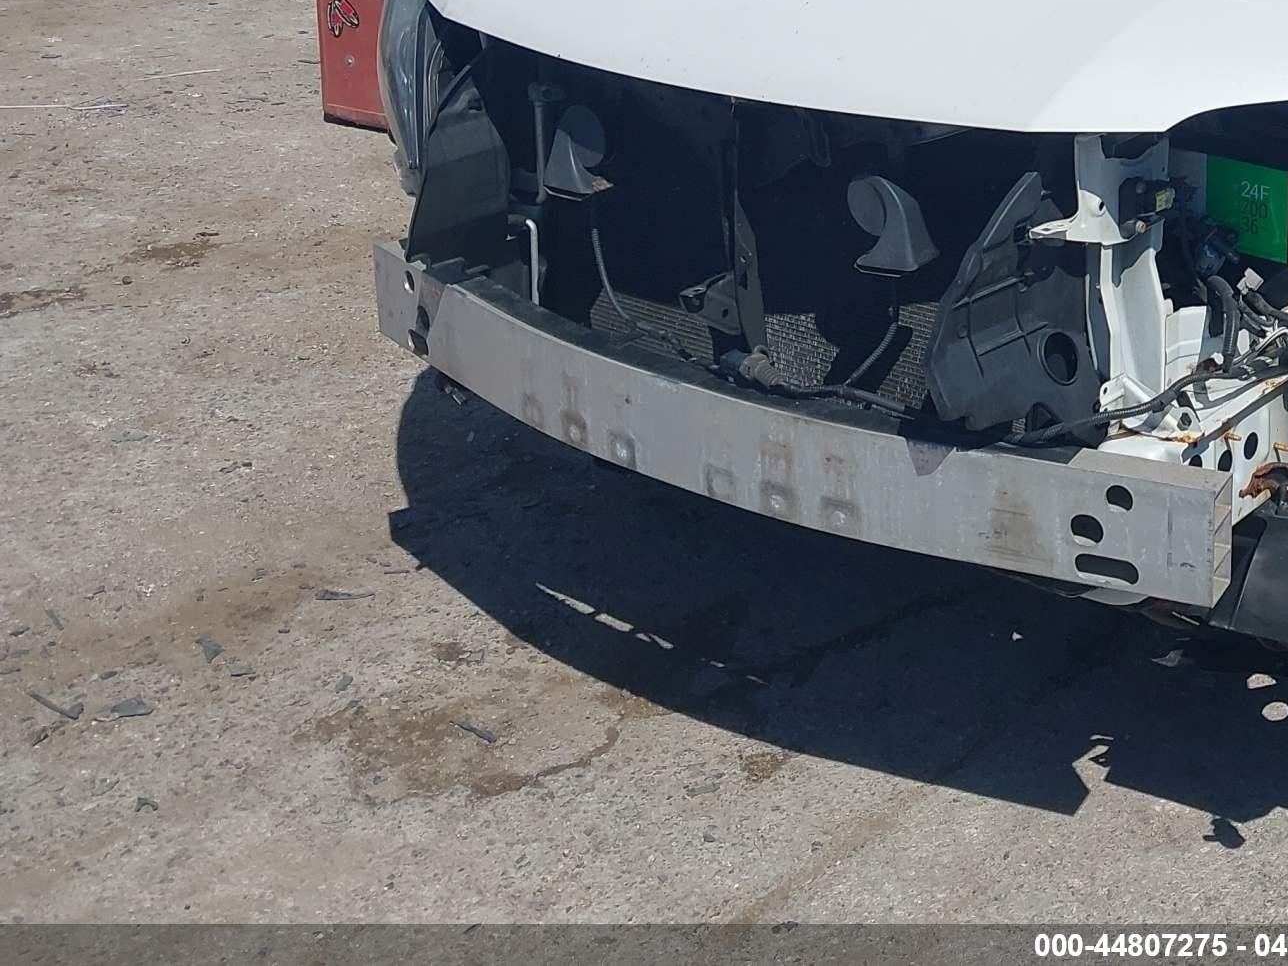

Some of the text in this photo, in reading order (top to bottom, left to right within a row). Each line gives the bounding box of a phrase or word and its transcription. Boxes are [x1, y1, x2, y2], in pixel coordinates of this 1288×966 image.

[1241, 181, 1270, 200] 24F
[1241, 199, 1268, 218] 700
[1241, 216, 1259, 234] 36
